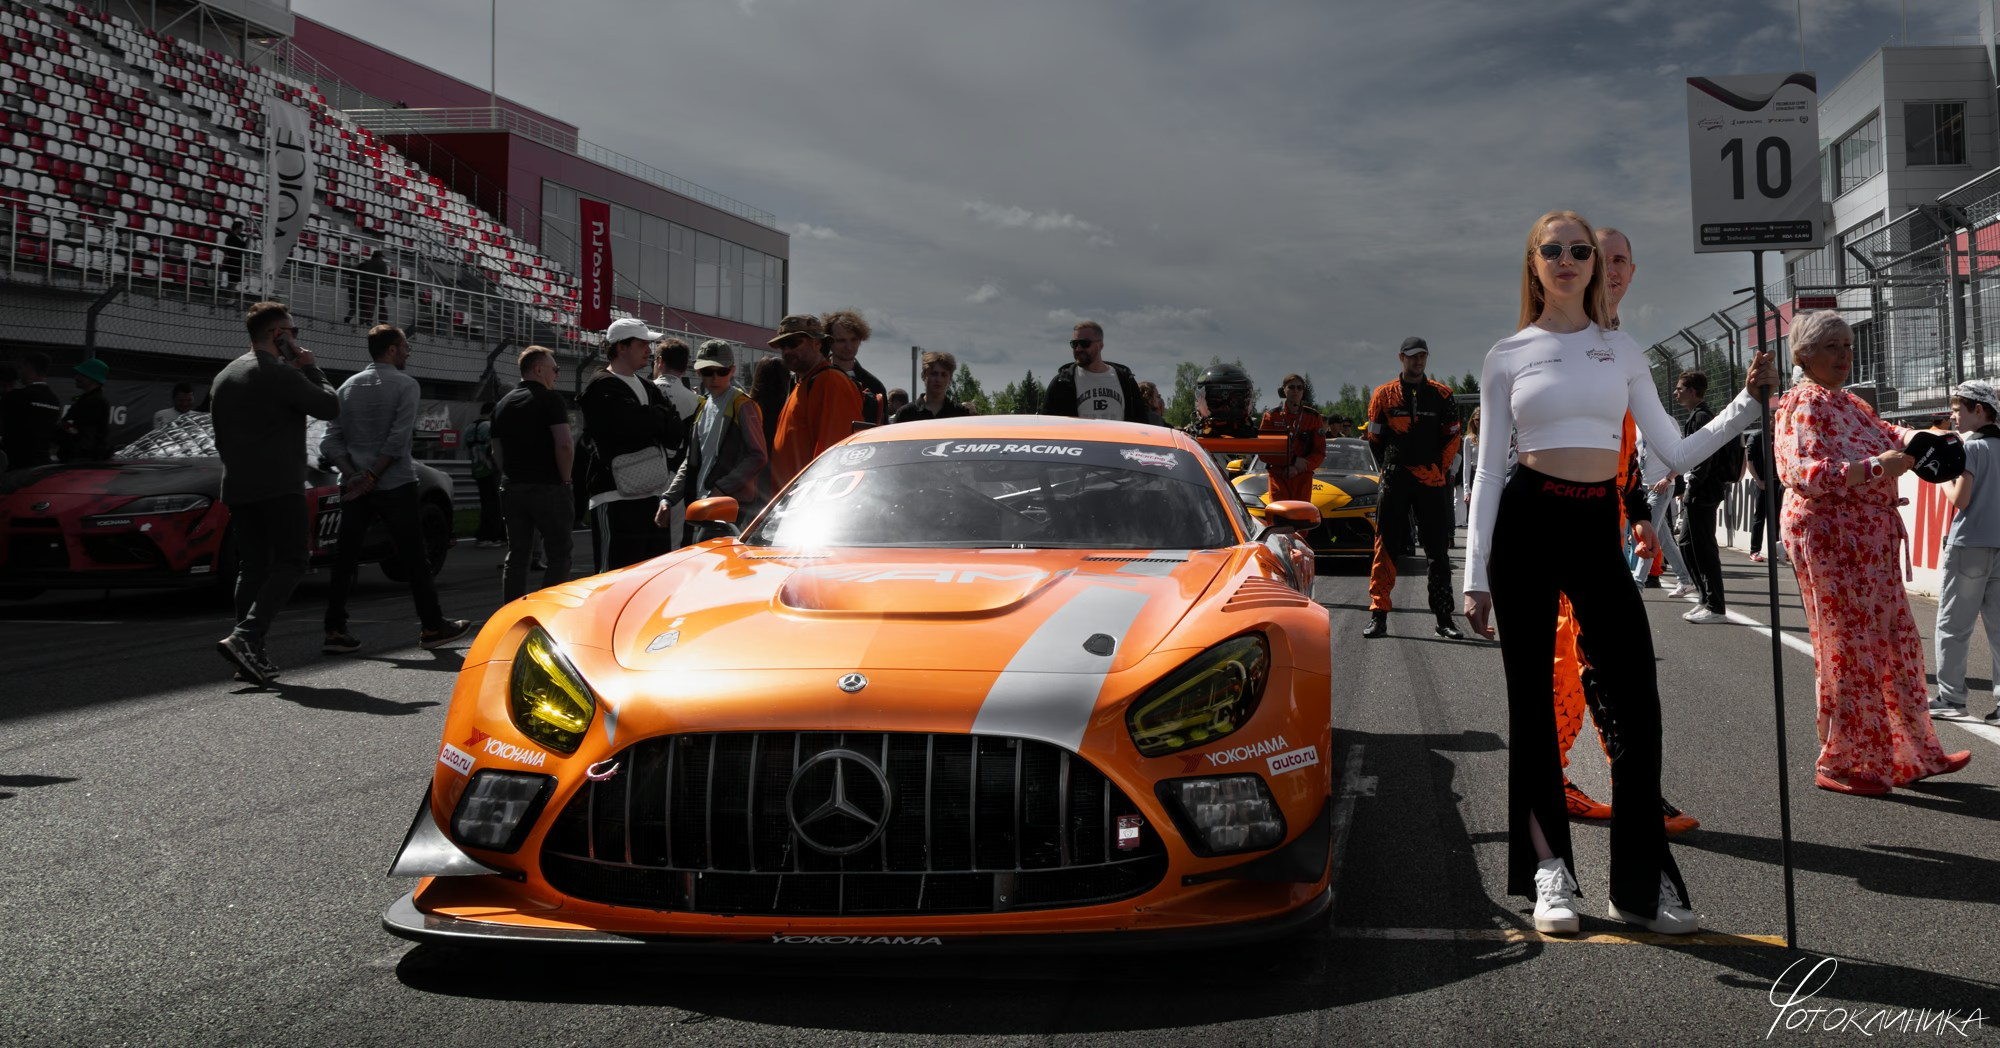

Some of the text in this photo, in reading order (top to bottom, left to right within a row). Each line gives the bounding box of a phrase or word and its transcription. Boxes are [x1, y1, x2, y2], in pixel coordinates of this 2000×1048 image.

[1720, 136, 1792, 200] 10
[592, 221, 604, 310] auto.ru
[952, 443, 1083, 457] SMP RACING
[1542, 480, 1607, 498] РСКГ.РФ
[319, 511, 343, 536] 111
[442, 747, 471, 771] auto.ru
[483, 737, 547, 767] YOKOHAMA
[1205, 735, 1288, 767] YOKOHAMA
[1272, 750, 1316, 770] auto.ru
[771, 935, 943, 945] YOKOHAMA
